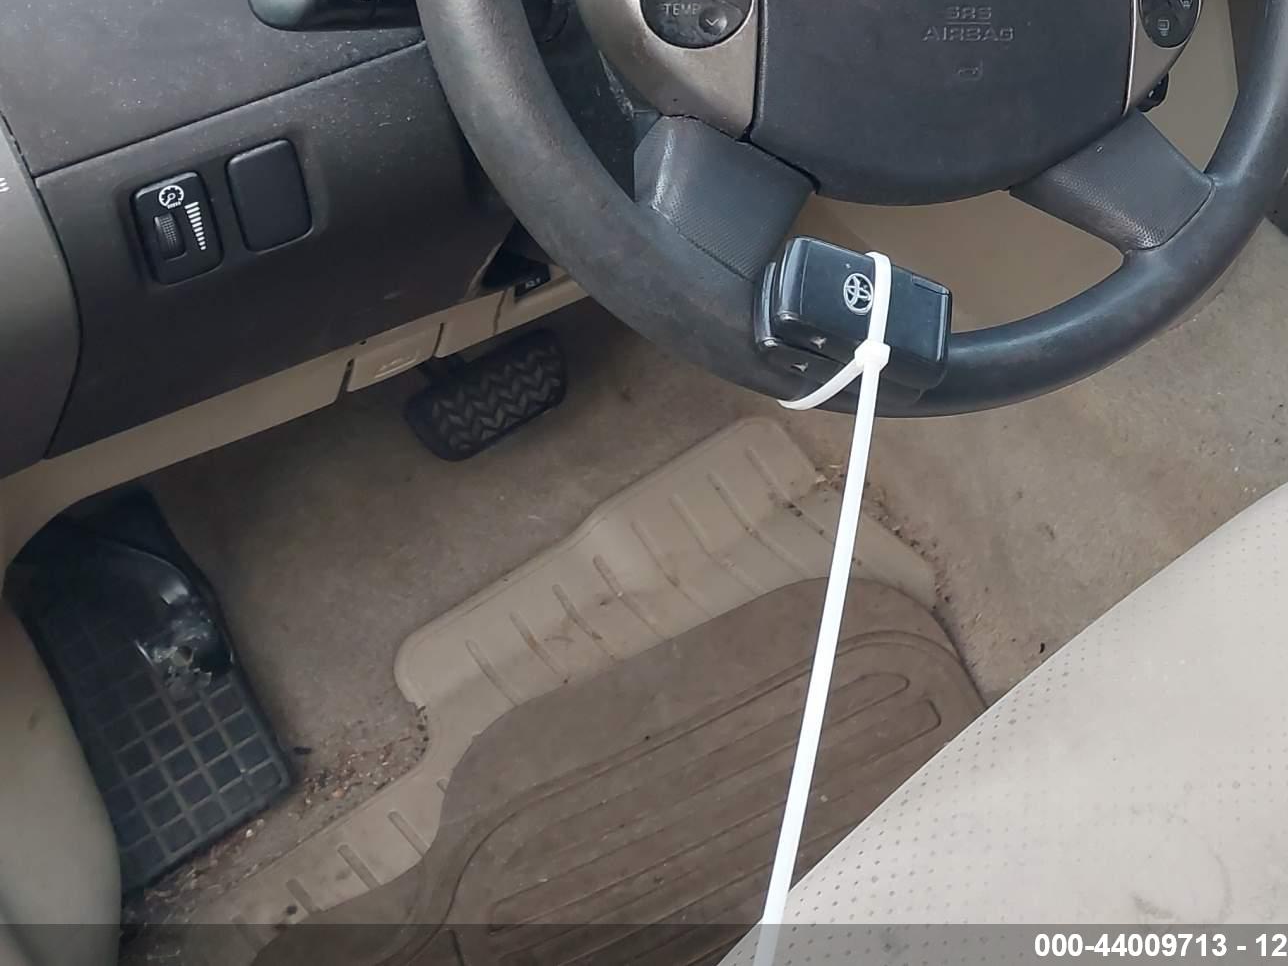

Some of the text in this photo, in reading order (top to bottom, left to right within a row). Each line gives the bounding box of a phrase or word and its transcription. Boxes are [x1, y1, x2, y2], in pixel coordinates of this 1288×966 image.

[663, 2, 700, 16] TEMP
[945, 5, 992, 20] SRS
[921, 25, 1015, 42] AIRBAG
